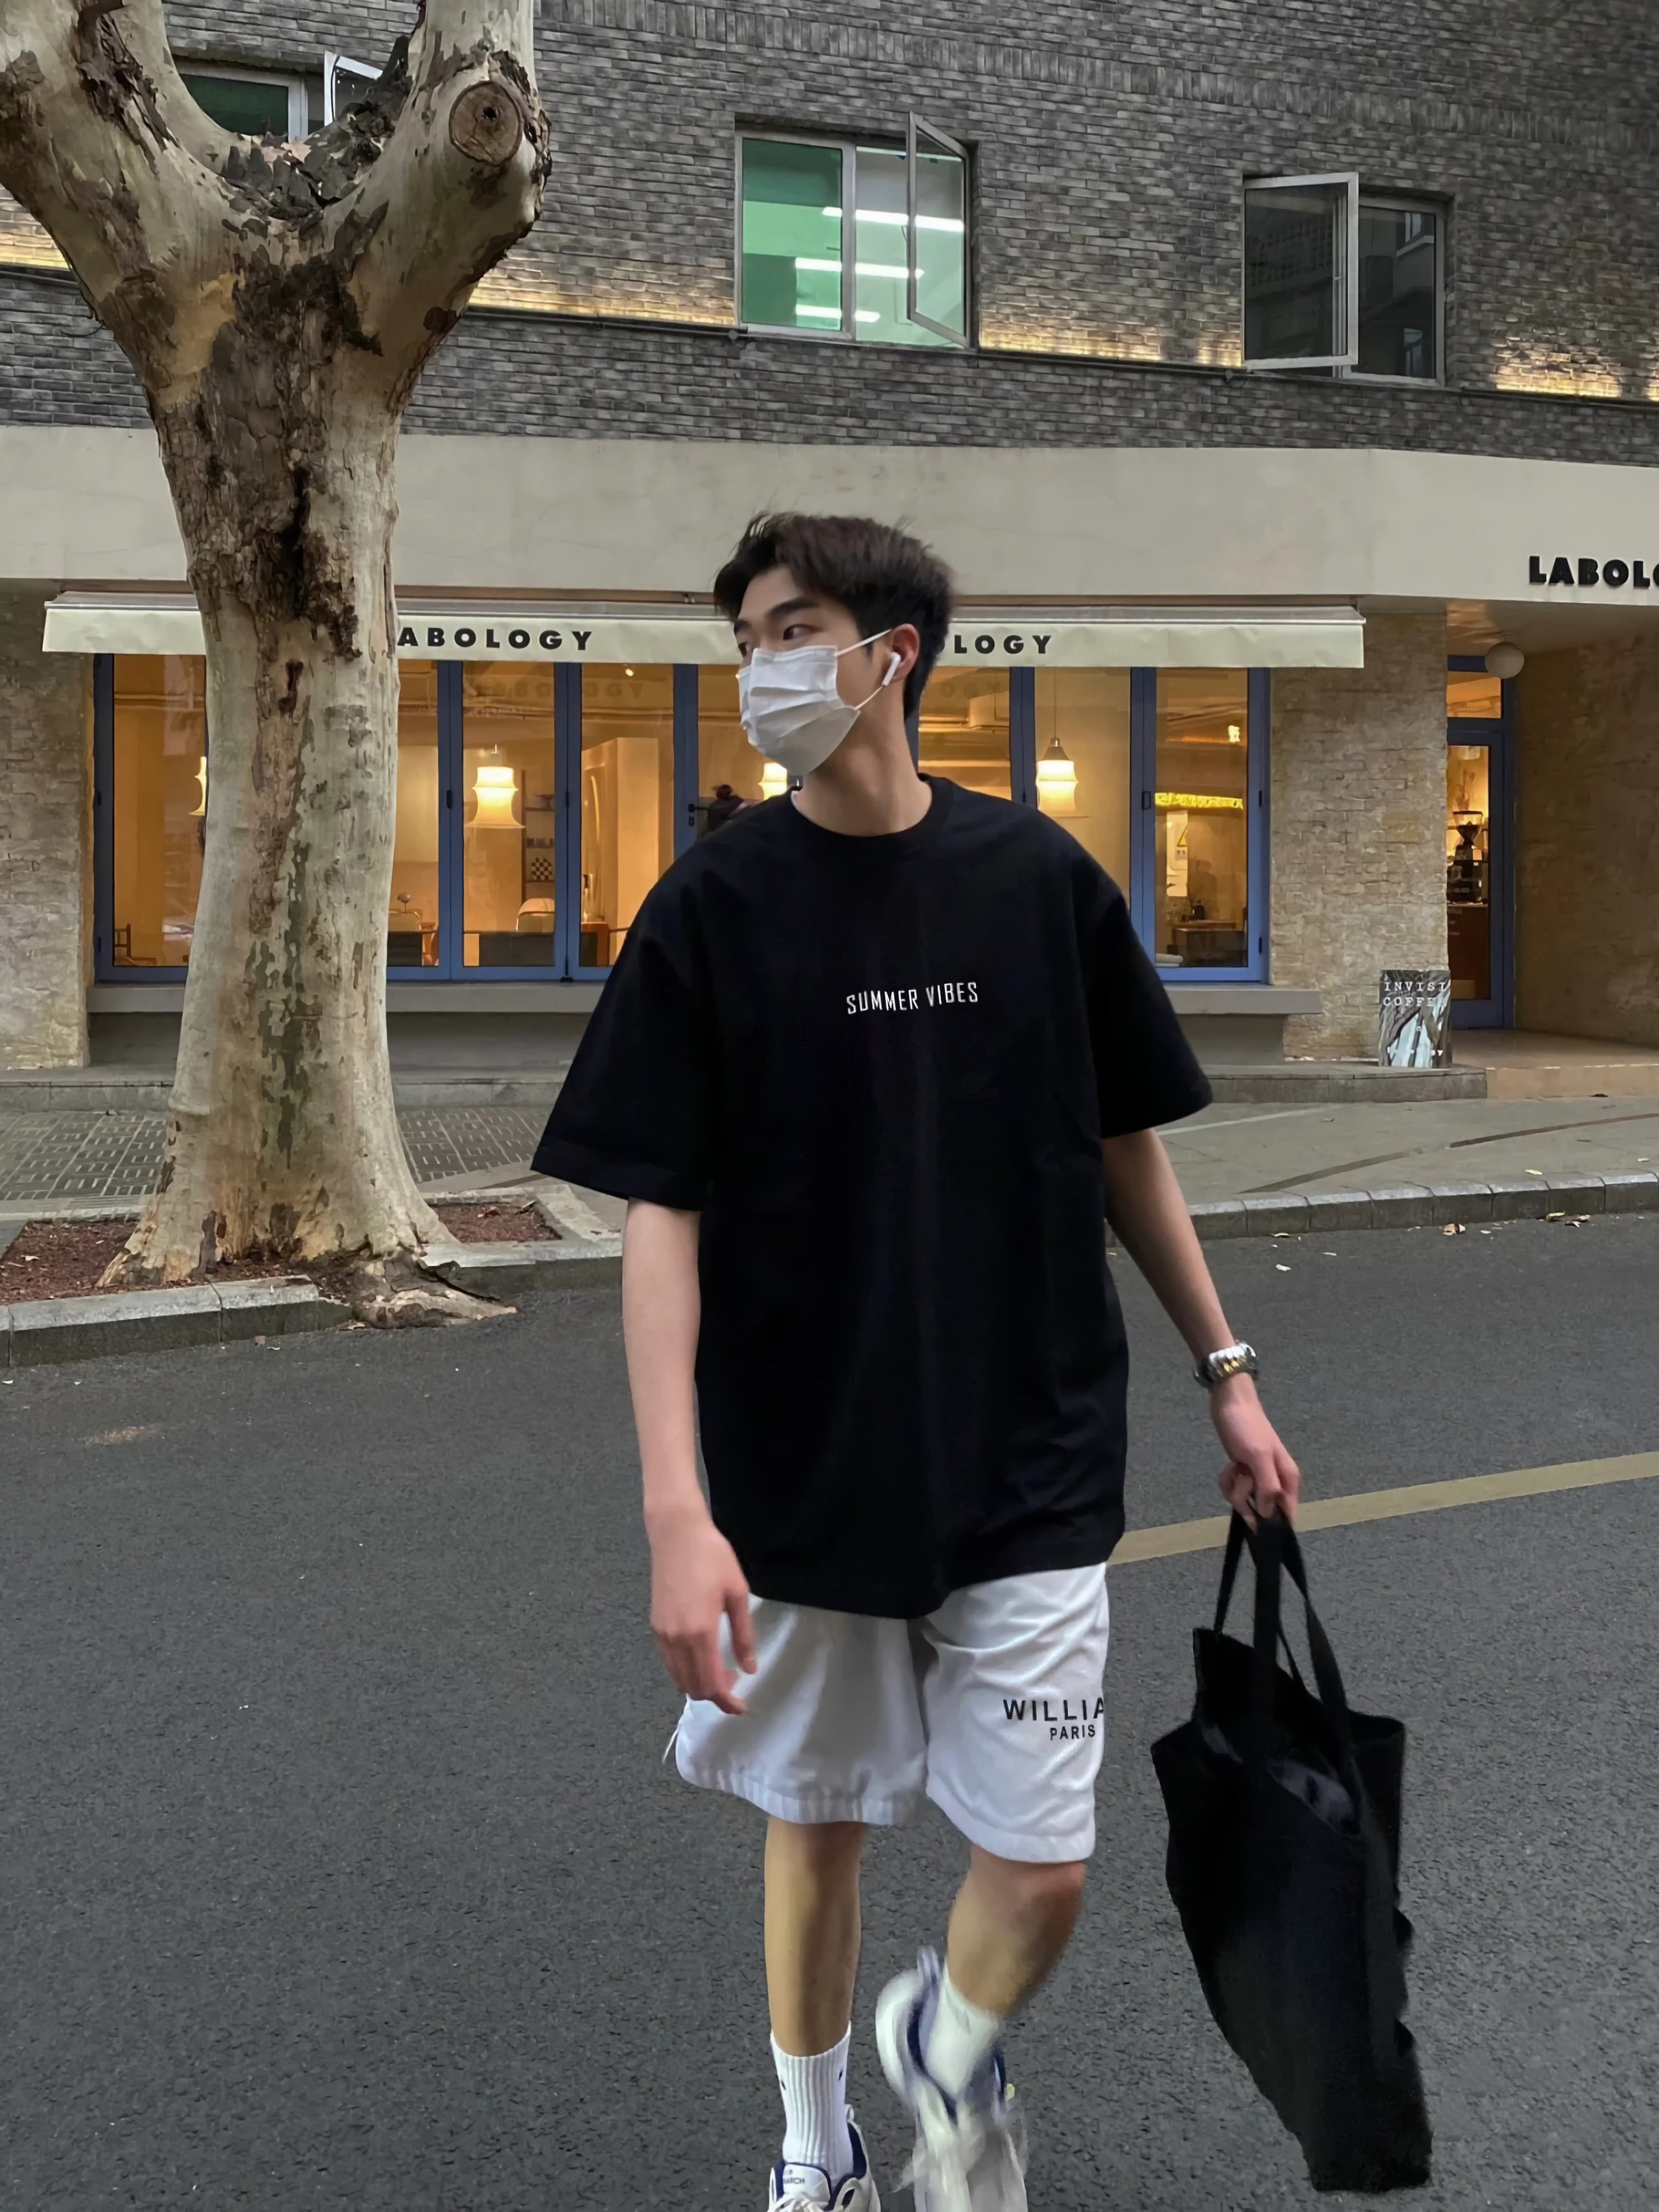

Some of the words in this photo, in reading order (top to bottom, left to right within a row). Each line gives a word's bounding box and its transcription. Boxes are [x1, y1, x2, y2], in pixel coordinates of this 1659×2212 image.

[1529, 555, 1659, 589] LABOL
[954, 634, 1052, 654] LOGY
[846, 989, 919, 1015] SUMMER
[925, 982, 978, 1007] VIBES
[1383, 997, 1444, 1007] COFFE
[1003, 1697, 1104, 1722] WILLIA
[1050, 1724, 1096, 1741] PARIS
